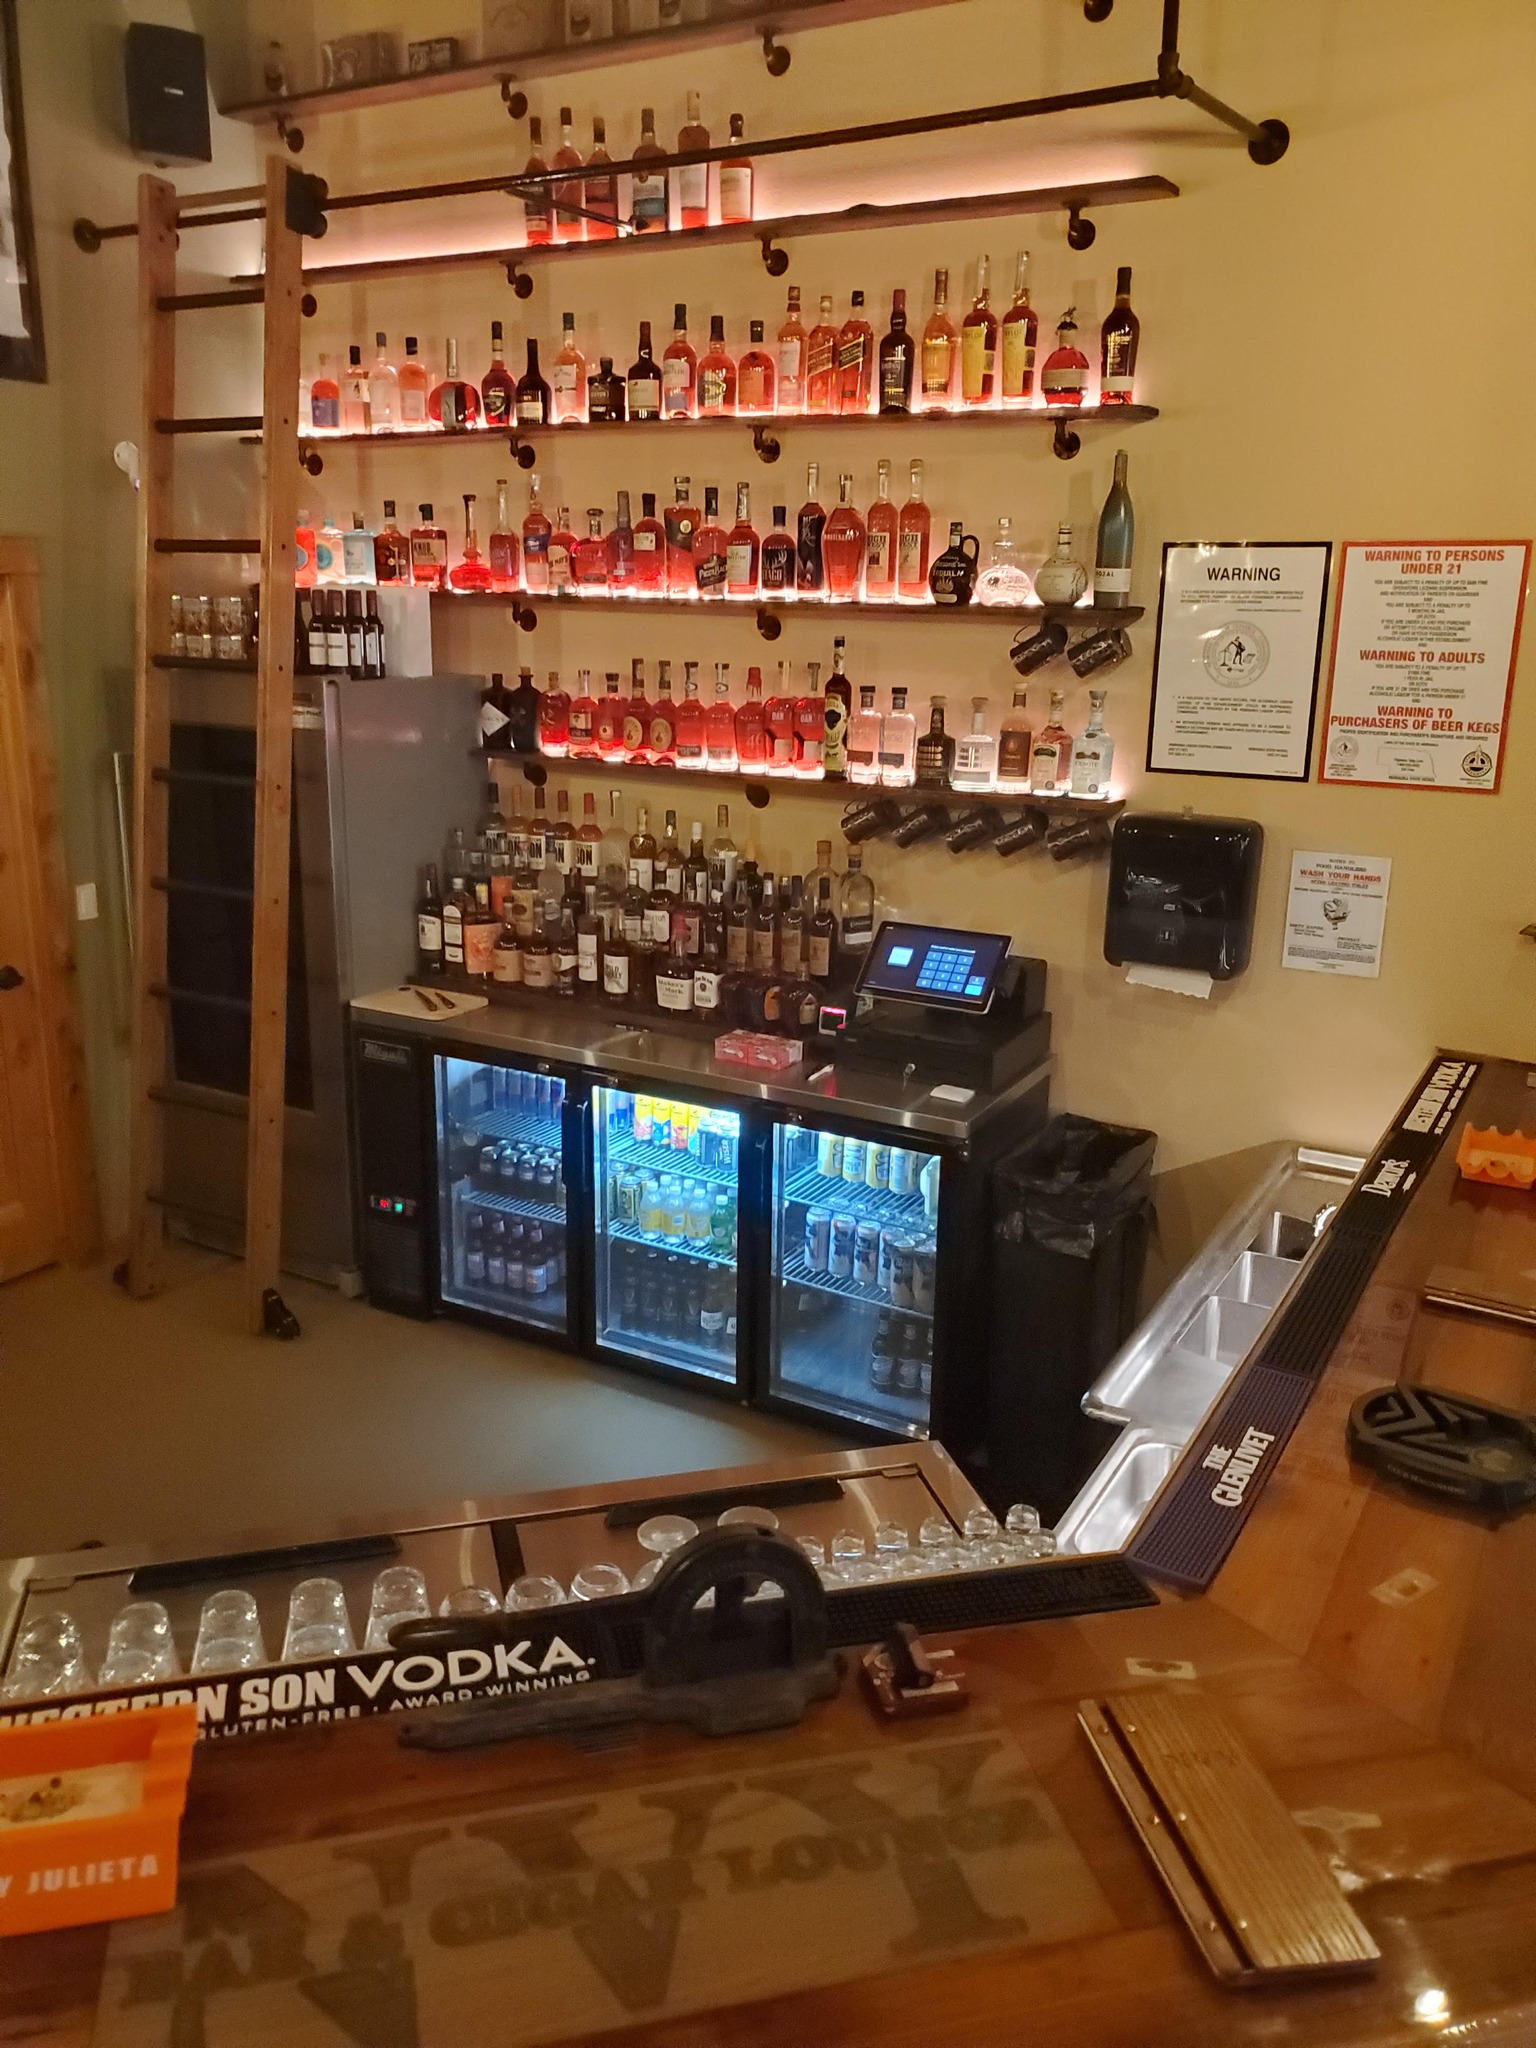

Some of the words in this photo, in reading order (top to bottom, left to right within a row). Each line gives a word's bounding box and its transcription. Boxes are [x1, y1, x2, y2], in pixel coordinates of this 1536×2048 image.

[1365, 551, 1421, 561] WARNING
[1428, 550, 1441, 561] TO
[1445, 550, 1505, 561] PERSONS
[1207, 567, 1281, 581] WARNING
[1401, 563, 1442, 574] UNDER
[1447, 563, 1462, 574] 21
[1360, 650, 1415, 662] WARNING
[1420, 651, 1434, 662] TO
[1438, 652, 1485, 664] ADULTS
[1377, 706, 1433, 718] WARNING
[1438, 707, 1453, 718] TO
[1331, 716, 1408, 729] PURCHASERS
[1412, 719, 1427, 730] OF
[1432, 720, 1463, 732] BEER
[1467, 721, 1500, 733] KEGS
[1300, 869, 1324, 877] WASH
[1328, 871, 1350, 880] YOUR
[1353, 874, 1381, 882] HANDS
[1202, 1444, 1232, 1471] THE
[1211, 1426, 1275, 1507] GLENLIVET
[239, 1668, 335, 1719] SON
[390, 1670, 591, 1711] AWARD-WINNING
[26, 1854, 158, 1895] JULIETA
